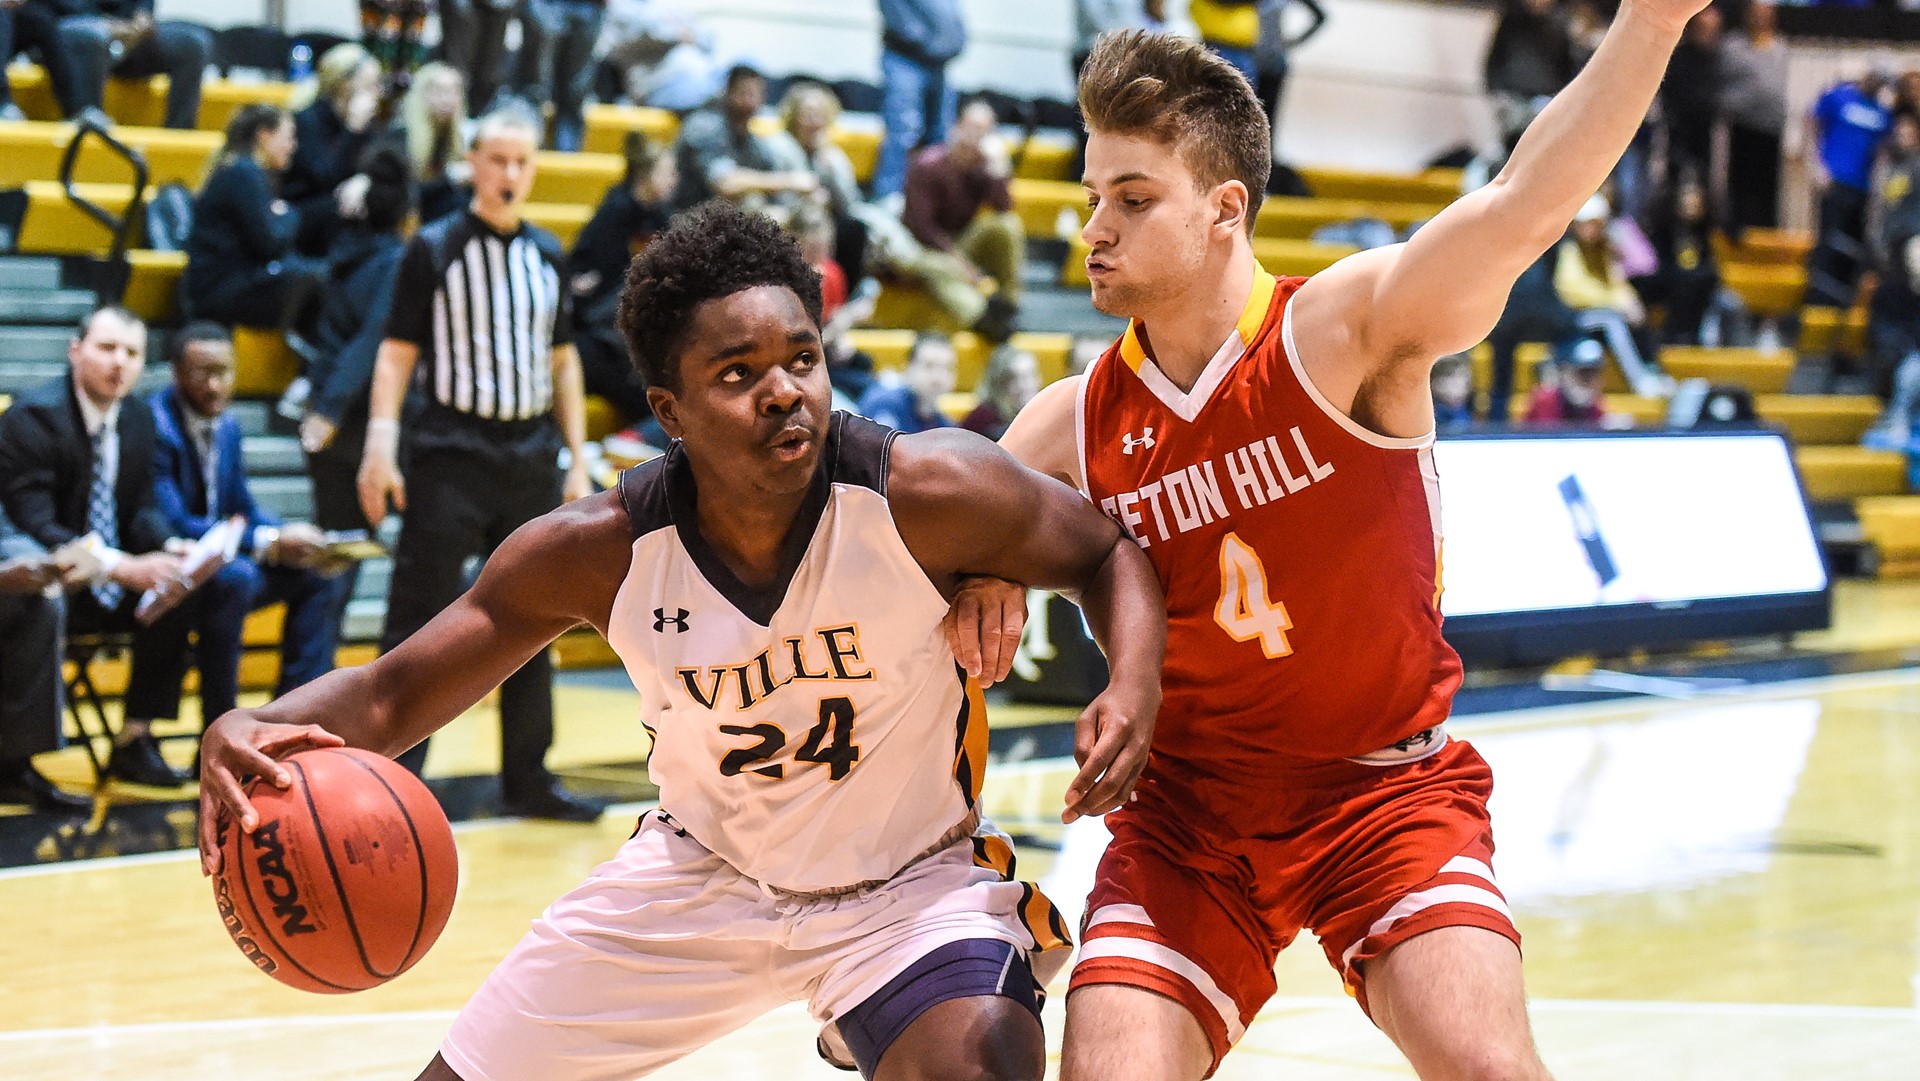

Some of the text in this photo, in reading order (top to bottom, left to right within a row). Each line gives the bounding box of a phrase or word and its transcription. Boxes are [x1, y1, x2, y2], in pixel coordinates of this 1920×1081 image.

[1225, 426, 1335, 509] HILL
[1214, 532, 1294, 660] 4
[675, 622, 877, 712] VILLE
[718, 696, 861, 782] 24
[252, 819, 317, 938] NCAA
